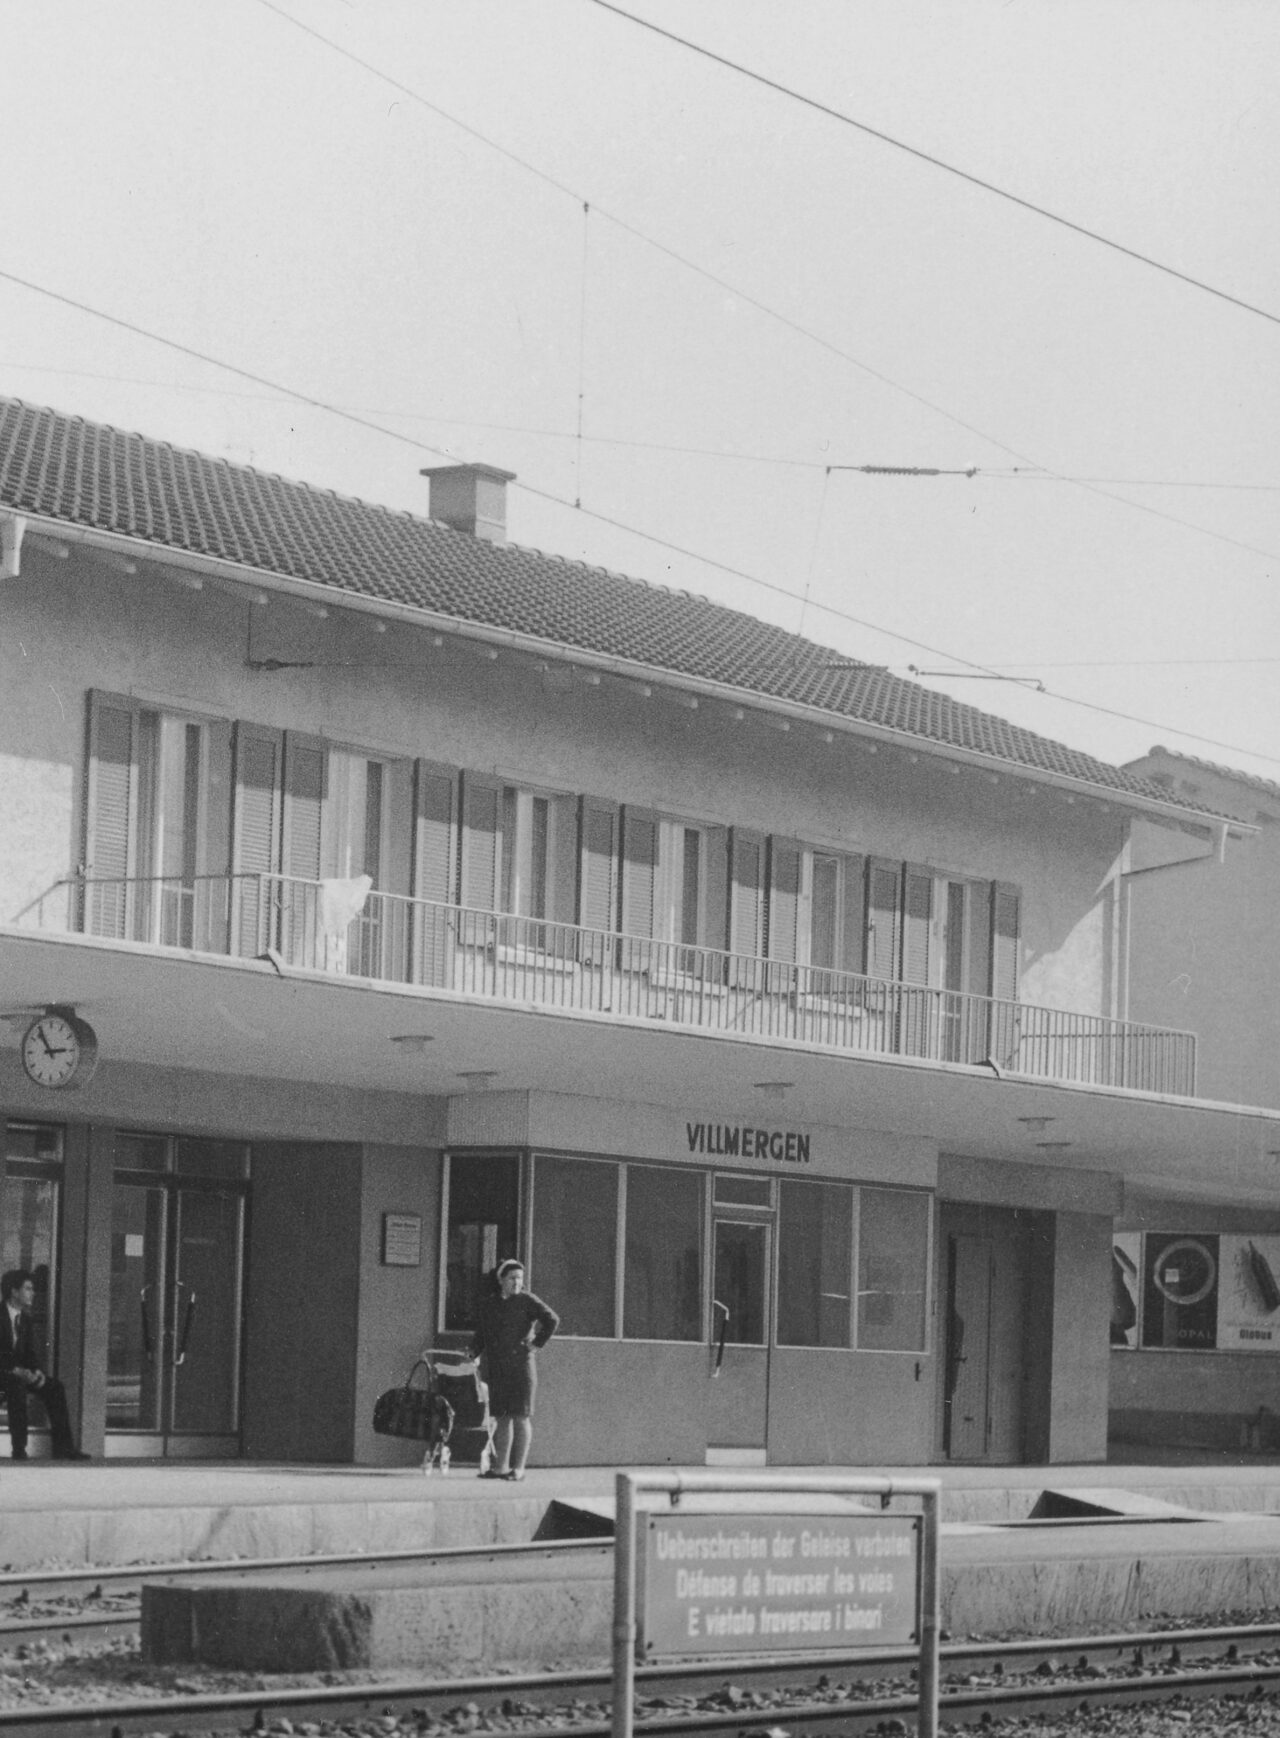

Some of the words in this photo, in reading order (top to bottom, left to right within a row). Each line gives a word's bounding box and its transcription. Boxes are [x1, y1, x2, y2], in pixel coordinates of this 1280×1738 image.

[686, 1122, 810, 1163] VILLMERGEN
[657, 1530, 768, 1560] Ueberschreiten
[772, 1530, 795, 1558] der
[800, 1530, 851, 1558] Geleise
[855, 1529, 912, 1557] verboten
[676, 1568, 737, 1599] Défense
[743, 1568, 761, 1597] de
[765, 1568, 829, 1596] traverser
[833, 1566, 855, 1594] les
[858, 1566, 893, 1594] voies
[705, 1607, 755, 1636] vietato
[760, 1605, 832, 1633] traversare
[835, 1603, 841, 1631] i
[844, 1602, 882, 1630] binari
